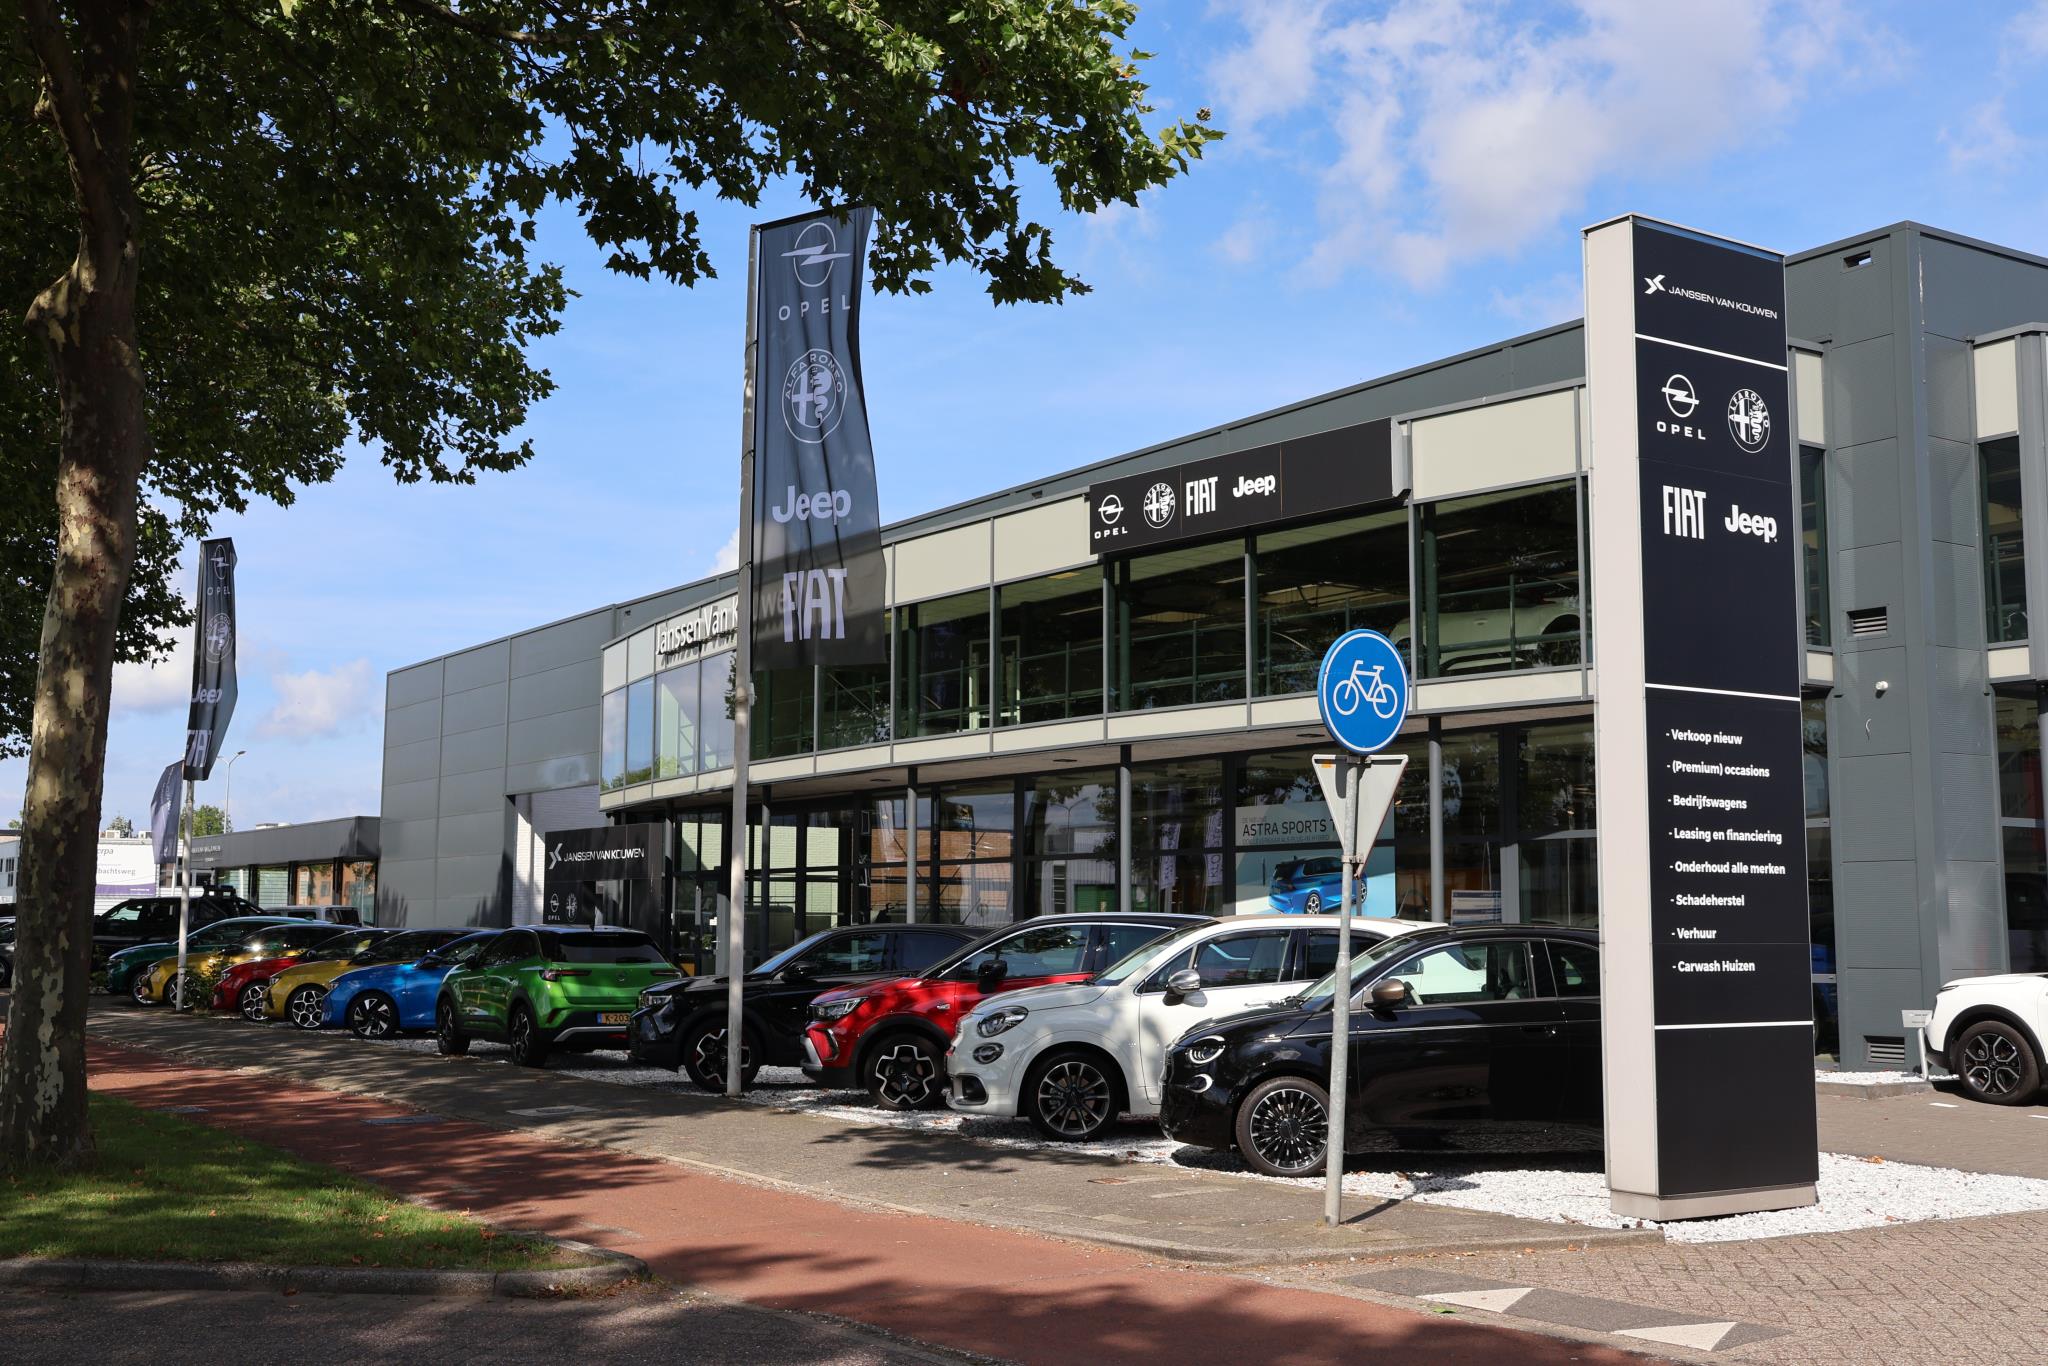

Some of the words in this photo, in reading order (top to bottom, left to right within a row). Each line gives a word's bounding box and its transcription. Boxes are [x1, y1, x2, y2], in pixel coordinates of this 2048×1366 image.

[778, 294, 851, 321] OPEL
[1668, 286, 1714, 304] JANSSEN
[1715, 297, 1735, 309] VAN
[1735, 302, 1778, 320] KOUWEN
[1656, 420, 1706, 440] OPEL
[1232, 474, 1277, 498] Jeep
[772, 485, 852, 526] Jeep
[1185, 476, 1219, 517] FIAT
[1662, 485, 1707, 540] FIAT
[1724, 504, 1778, 543] Jeep
[1094, 526, 1129, 540] OPEL
[783, 568, 848, 643] FIAT
[656, 618, 702, 655] Janssen
[703, 604, 729, 637] Van
[1671, 728, 1712, 745] Verkoop
[1713, 731, 1743, 745] nieuw
[1672, 760, 1723, 776] (Premium)
[1724, 764, 1770, 777] occasions
[1673, 794, 1748, 811] Bedrijfswagens
[1242, 822, 1279, 837] ASTRA
[1282, 819, 1327, 835] SPORTS
[1674, 827, 1712, 842] Leasing
[1712, 831, 1726, 841] en
[1727, 828, 1782, 845] financiering
[563, 850, 596, 862] JANSSEN
[596, 849, 611, 860] VAN
[611, 847, 645, 859] KOUWEN
[97, 868, 136, 877] bachtsweg
[1675, 861, 1730, 873] Onderhoud
[1731, 862, 1749, 874] alle
[1750, 863, 1786, 875] merken
[1676, 894, 1745, 906] Schadeherstel
[1676, 927, 1717, 939] Verhuur
[1677, 960, 1720, 972] Carwash
[1722, 960, 1756, 972] Huizen
